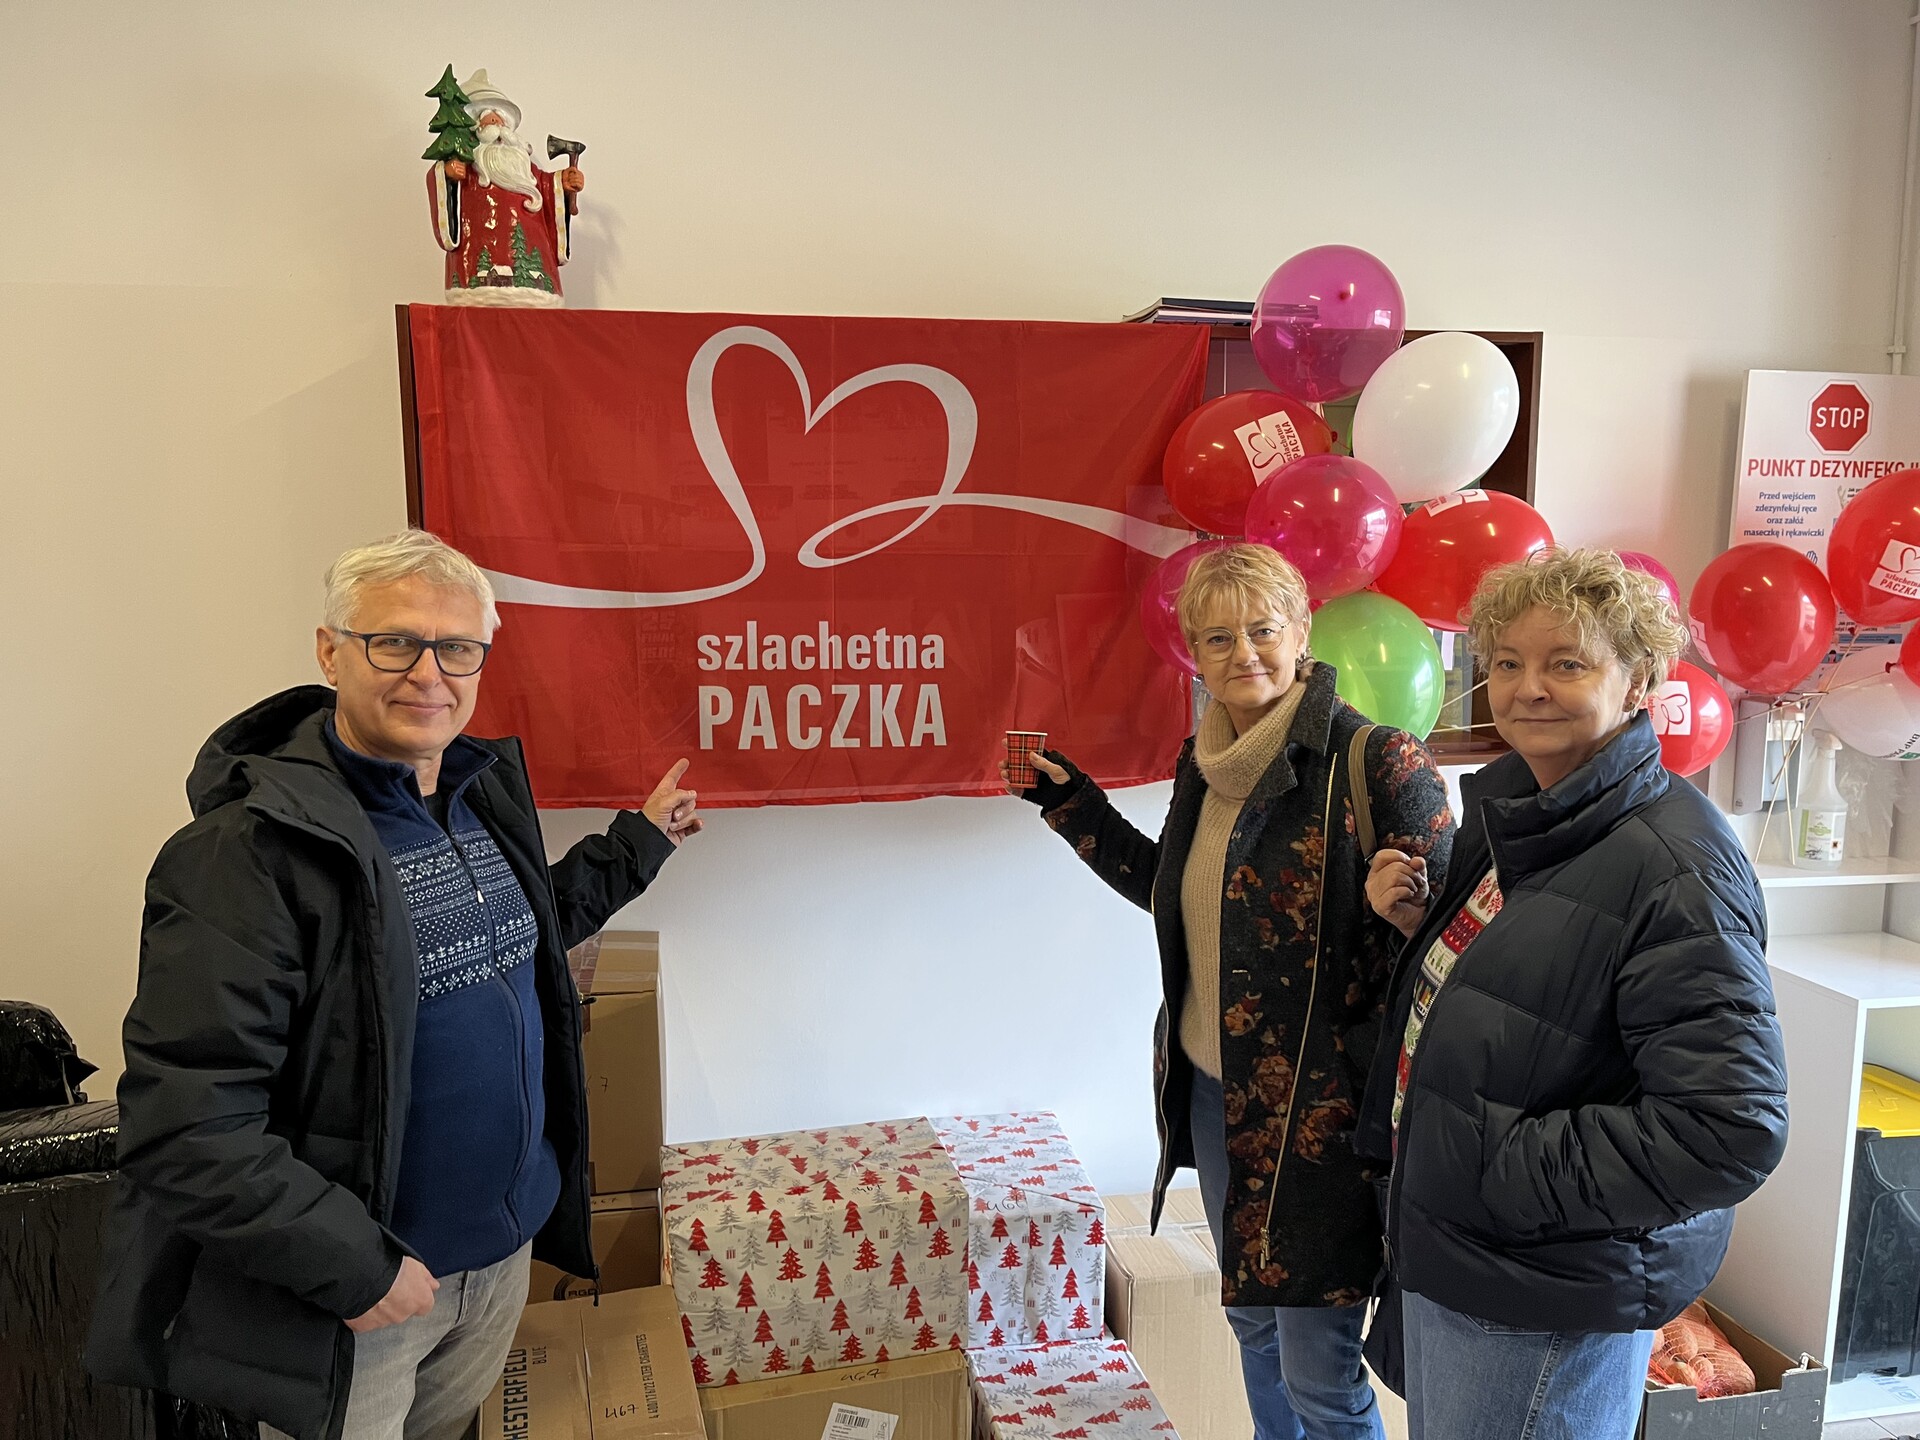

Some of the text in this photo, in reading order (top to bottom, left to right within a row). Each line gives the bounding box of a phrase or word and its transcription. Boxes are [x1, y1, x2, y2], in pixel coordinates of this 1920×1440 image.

[1815, 406, 1865, 429] STOP
[1275, 424, 1292, 462] szlachetna
[1282, 421, 1302, 460] PACZKA
[1747, 458, 1806, 477] PUNKT
[1758, 491, 1816, 502] Przed wejściem
[1755, 504, 1818, 514] zdezynfekuj ręce
[1784, 516, 1804, 524] załóż
[1743, 528, 1780, 538] maseczkę
[1785, 529, 1825, 538] rękawiczki
[1879, 578, 1918, 596] PACZKA
[697, 620, 945, 671] szlachetna
[699, 683, 947, 750] PACZKA
[532, 1345, 547, 1365] BLUE
[635, 1333, 651, 1364] CIGARETTES
[640, 1364, 654, 1382] FILTER
[605, 1403, 639, 1419] 467
